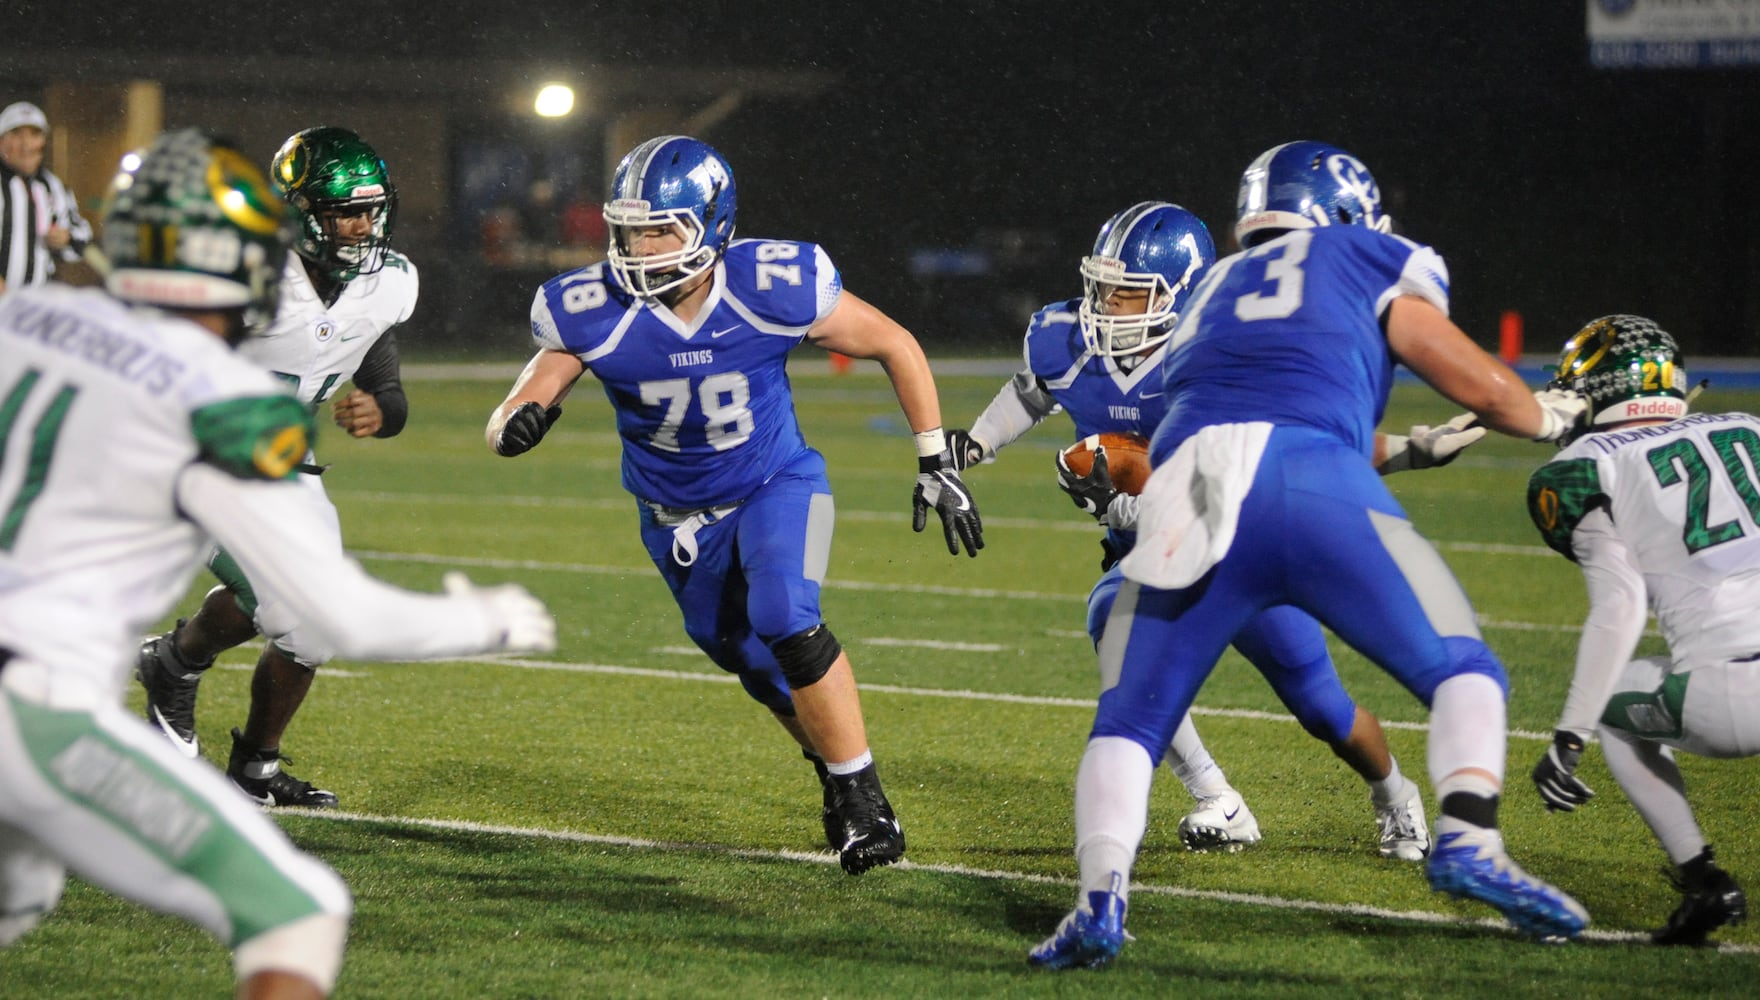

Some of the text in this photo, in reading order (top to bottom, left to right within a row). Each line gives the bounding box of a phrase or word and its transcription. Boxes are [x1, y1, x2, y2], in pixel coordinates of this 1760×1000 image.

[559, 262, 608, 315] 78
[756, 243, 801, 291] 78
[668, 349, 714, 368] VIKINGS
[1642, 361, 1674, 390] 20
[638, 370, 756, 453] 78
[1626, 402, 1683, 416] Riddell
[1646, 426, 1760, 556] 20
